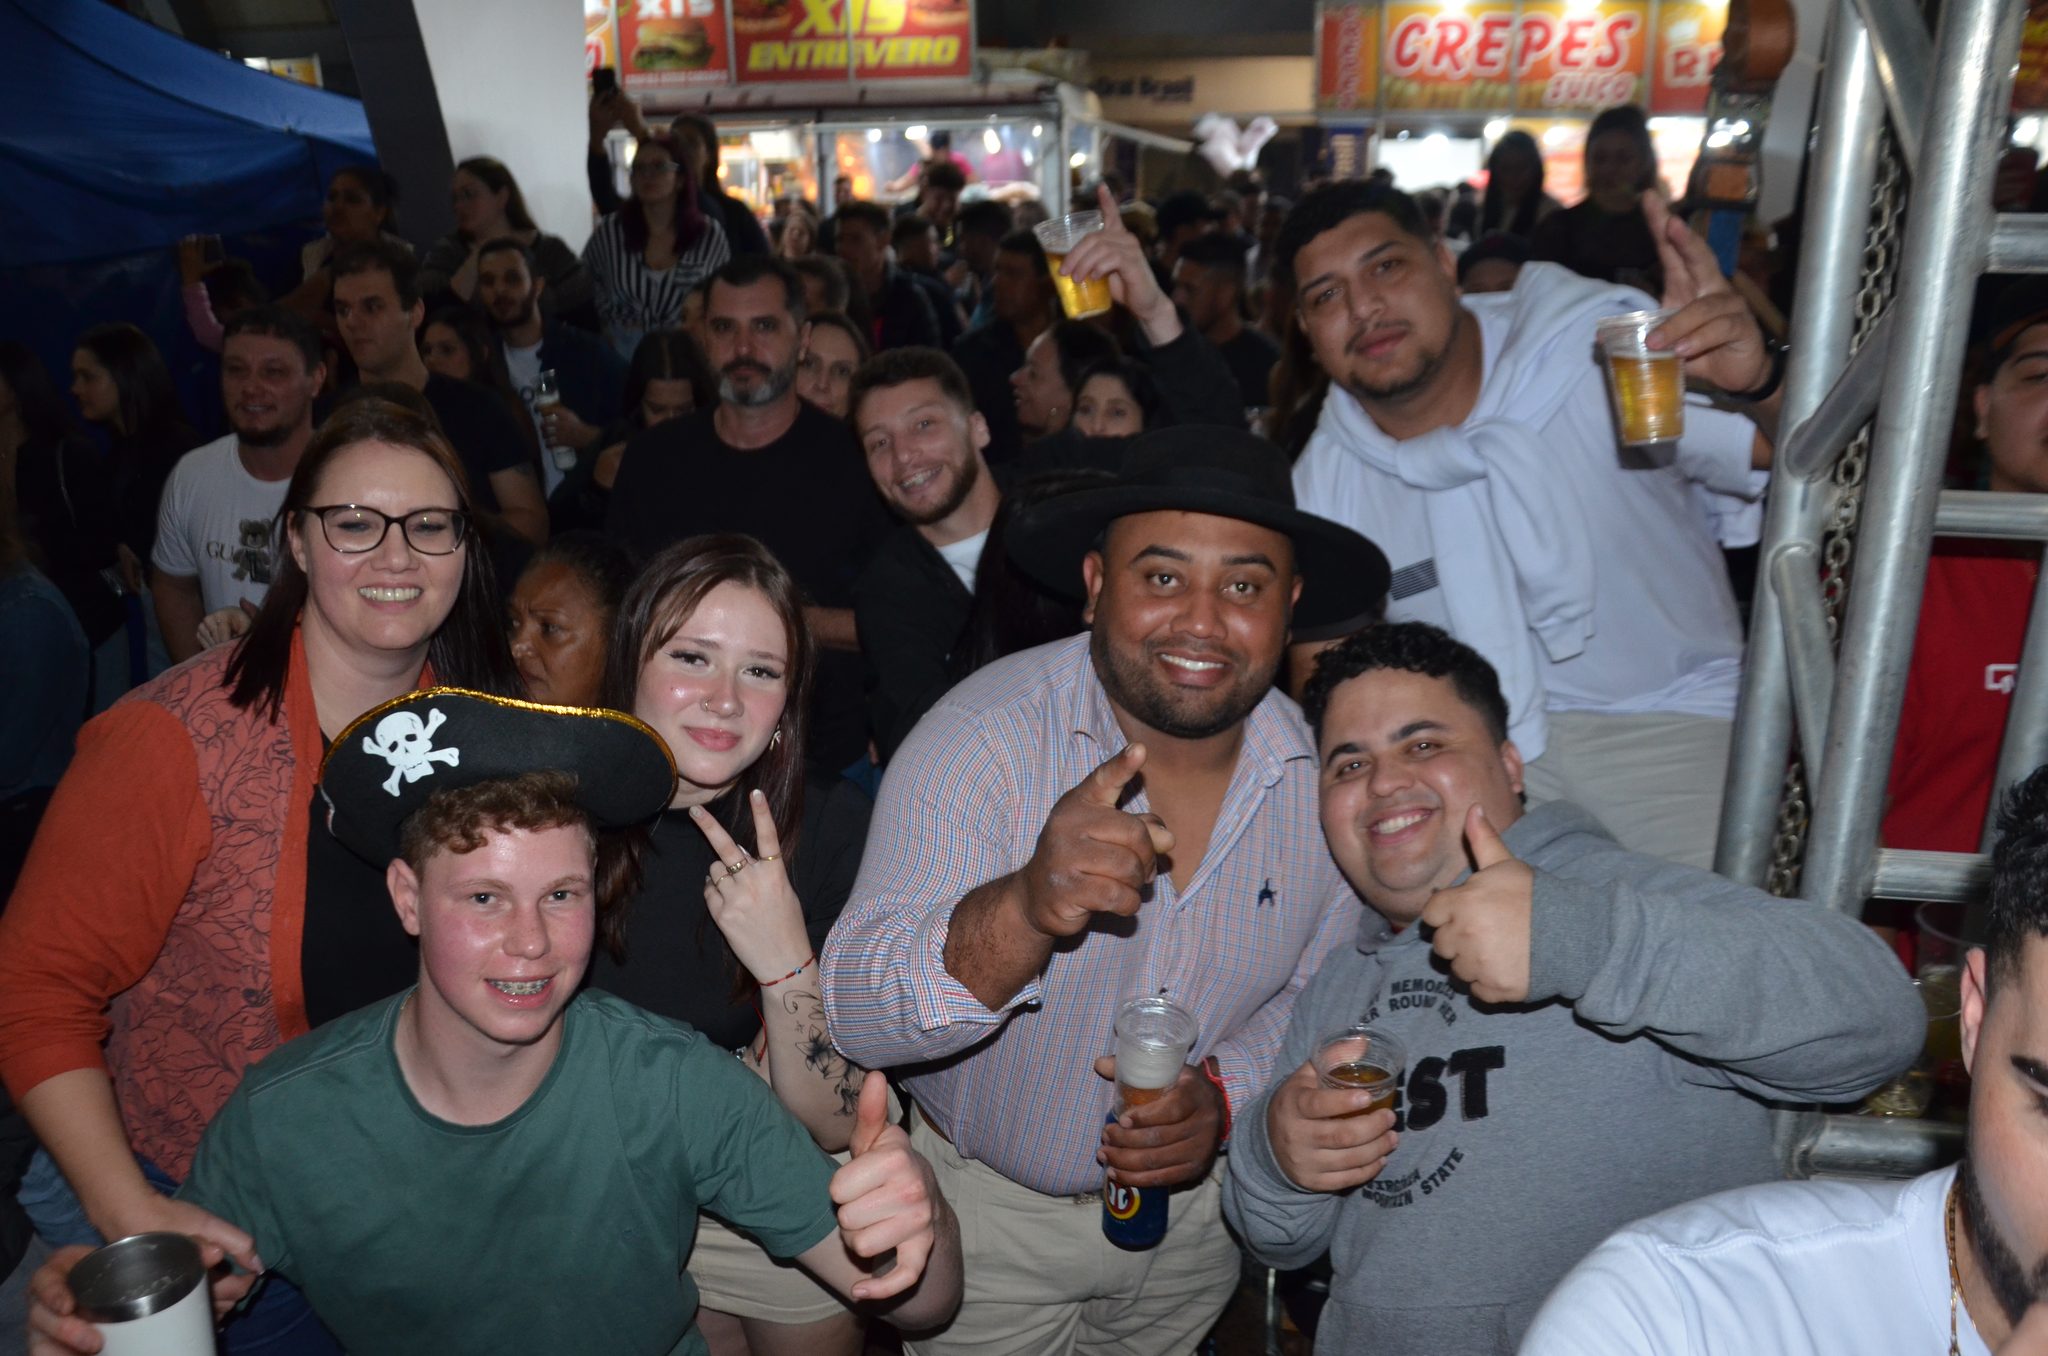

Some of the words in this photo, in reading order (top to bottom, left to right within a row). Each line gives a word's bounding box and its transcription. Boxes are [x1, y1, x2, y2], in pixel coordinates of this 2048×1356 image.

[748, 37, 960, 71] ENTREVERO
[1391, 15, 1637, 75] CREPES
[1420, 1147, 1464, 1195] STATE
